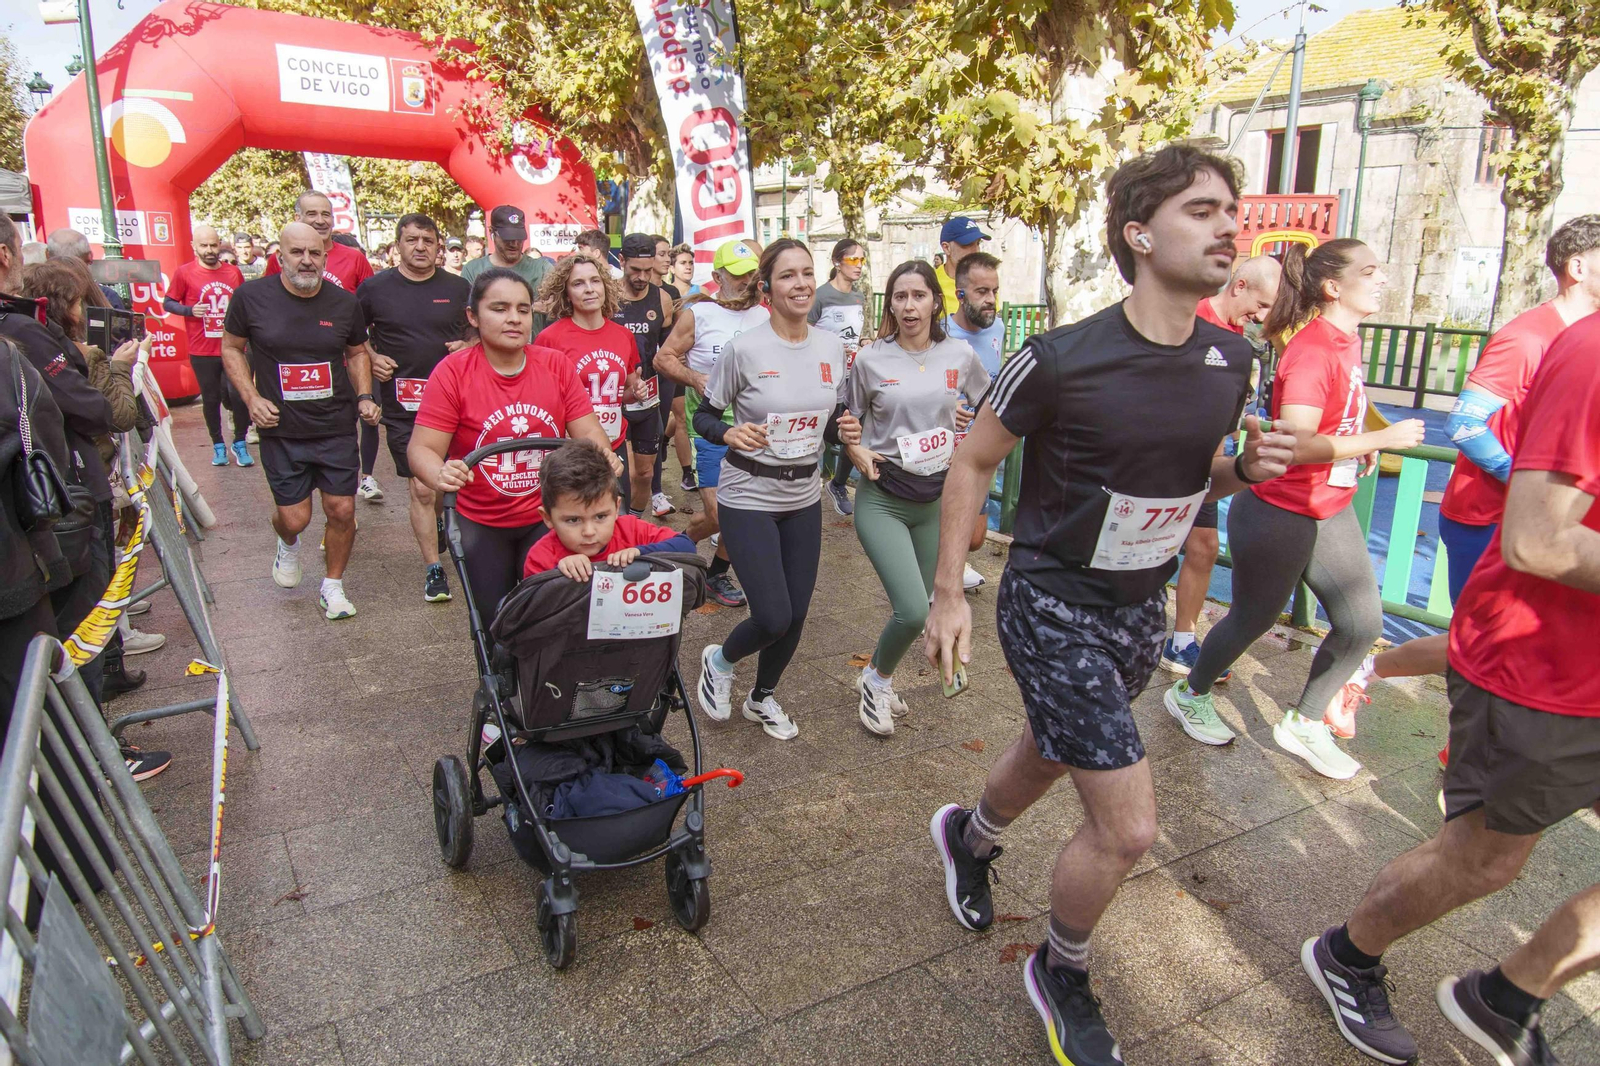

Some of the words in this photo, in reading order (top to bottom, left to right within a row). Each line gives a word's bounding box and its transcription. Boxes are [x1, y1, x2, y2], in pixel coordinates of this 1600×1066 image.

[692, 39, 706, 73] teu
[287, 57, 379, 80] CONCELLO
[300, 77, 323, 92] DE
[329, 79, 370, 97] VIGO
[84, 227, 99, 236] DE
[534, 230, 578, 238] CONCELLO
[540, 238, 551, 246] DE
[208, 294, 230, 314] 14
[577, 354, 592, 371] #EU
[591, 348, 626, 368] MÓVOME
[1205, 358, 1228, 367] adidas
[300, 368, 321, 382] 24
[413, 383, 427, 395] 2
[588, 371, 620, 404] 14
[483, 410, 505, 431] #EU
[505, 402, 554, 426] MÓVOME
[788, 416, 818, 434] 754
[918, 431, 947, 453] 803
[497, 432, 543, 473] 14
[492, 472, 510, 482] POLA
[1119, 505, 1130, 515] 14
[1140, 503, 1192, 531] 774
[602, 582, 610, 590] 14
[622, 582, 672, 604] 668
